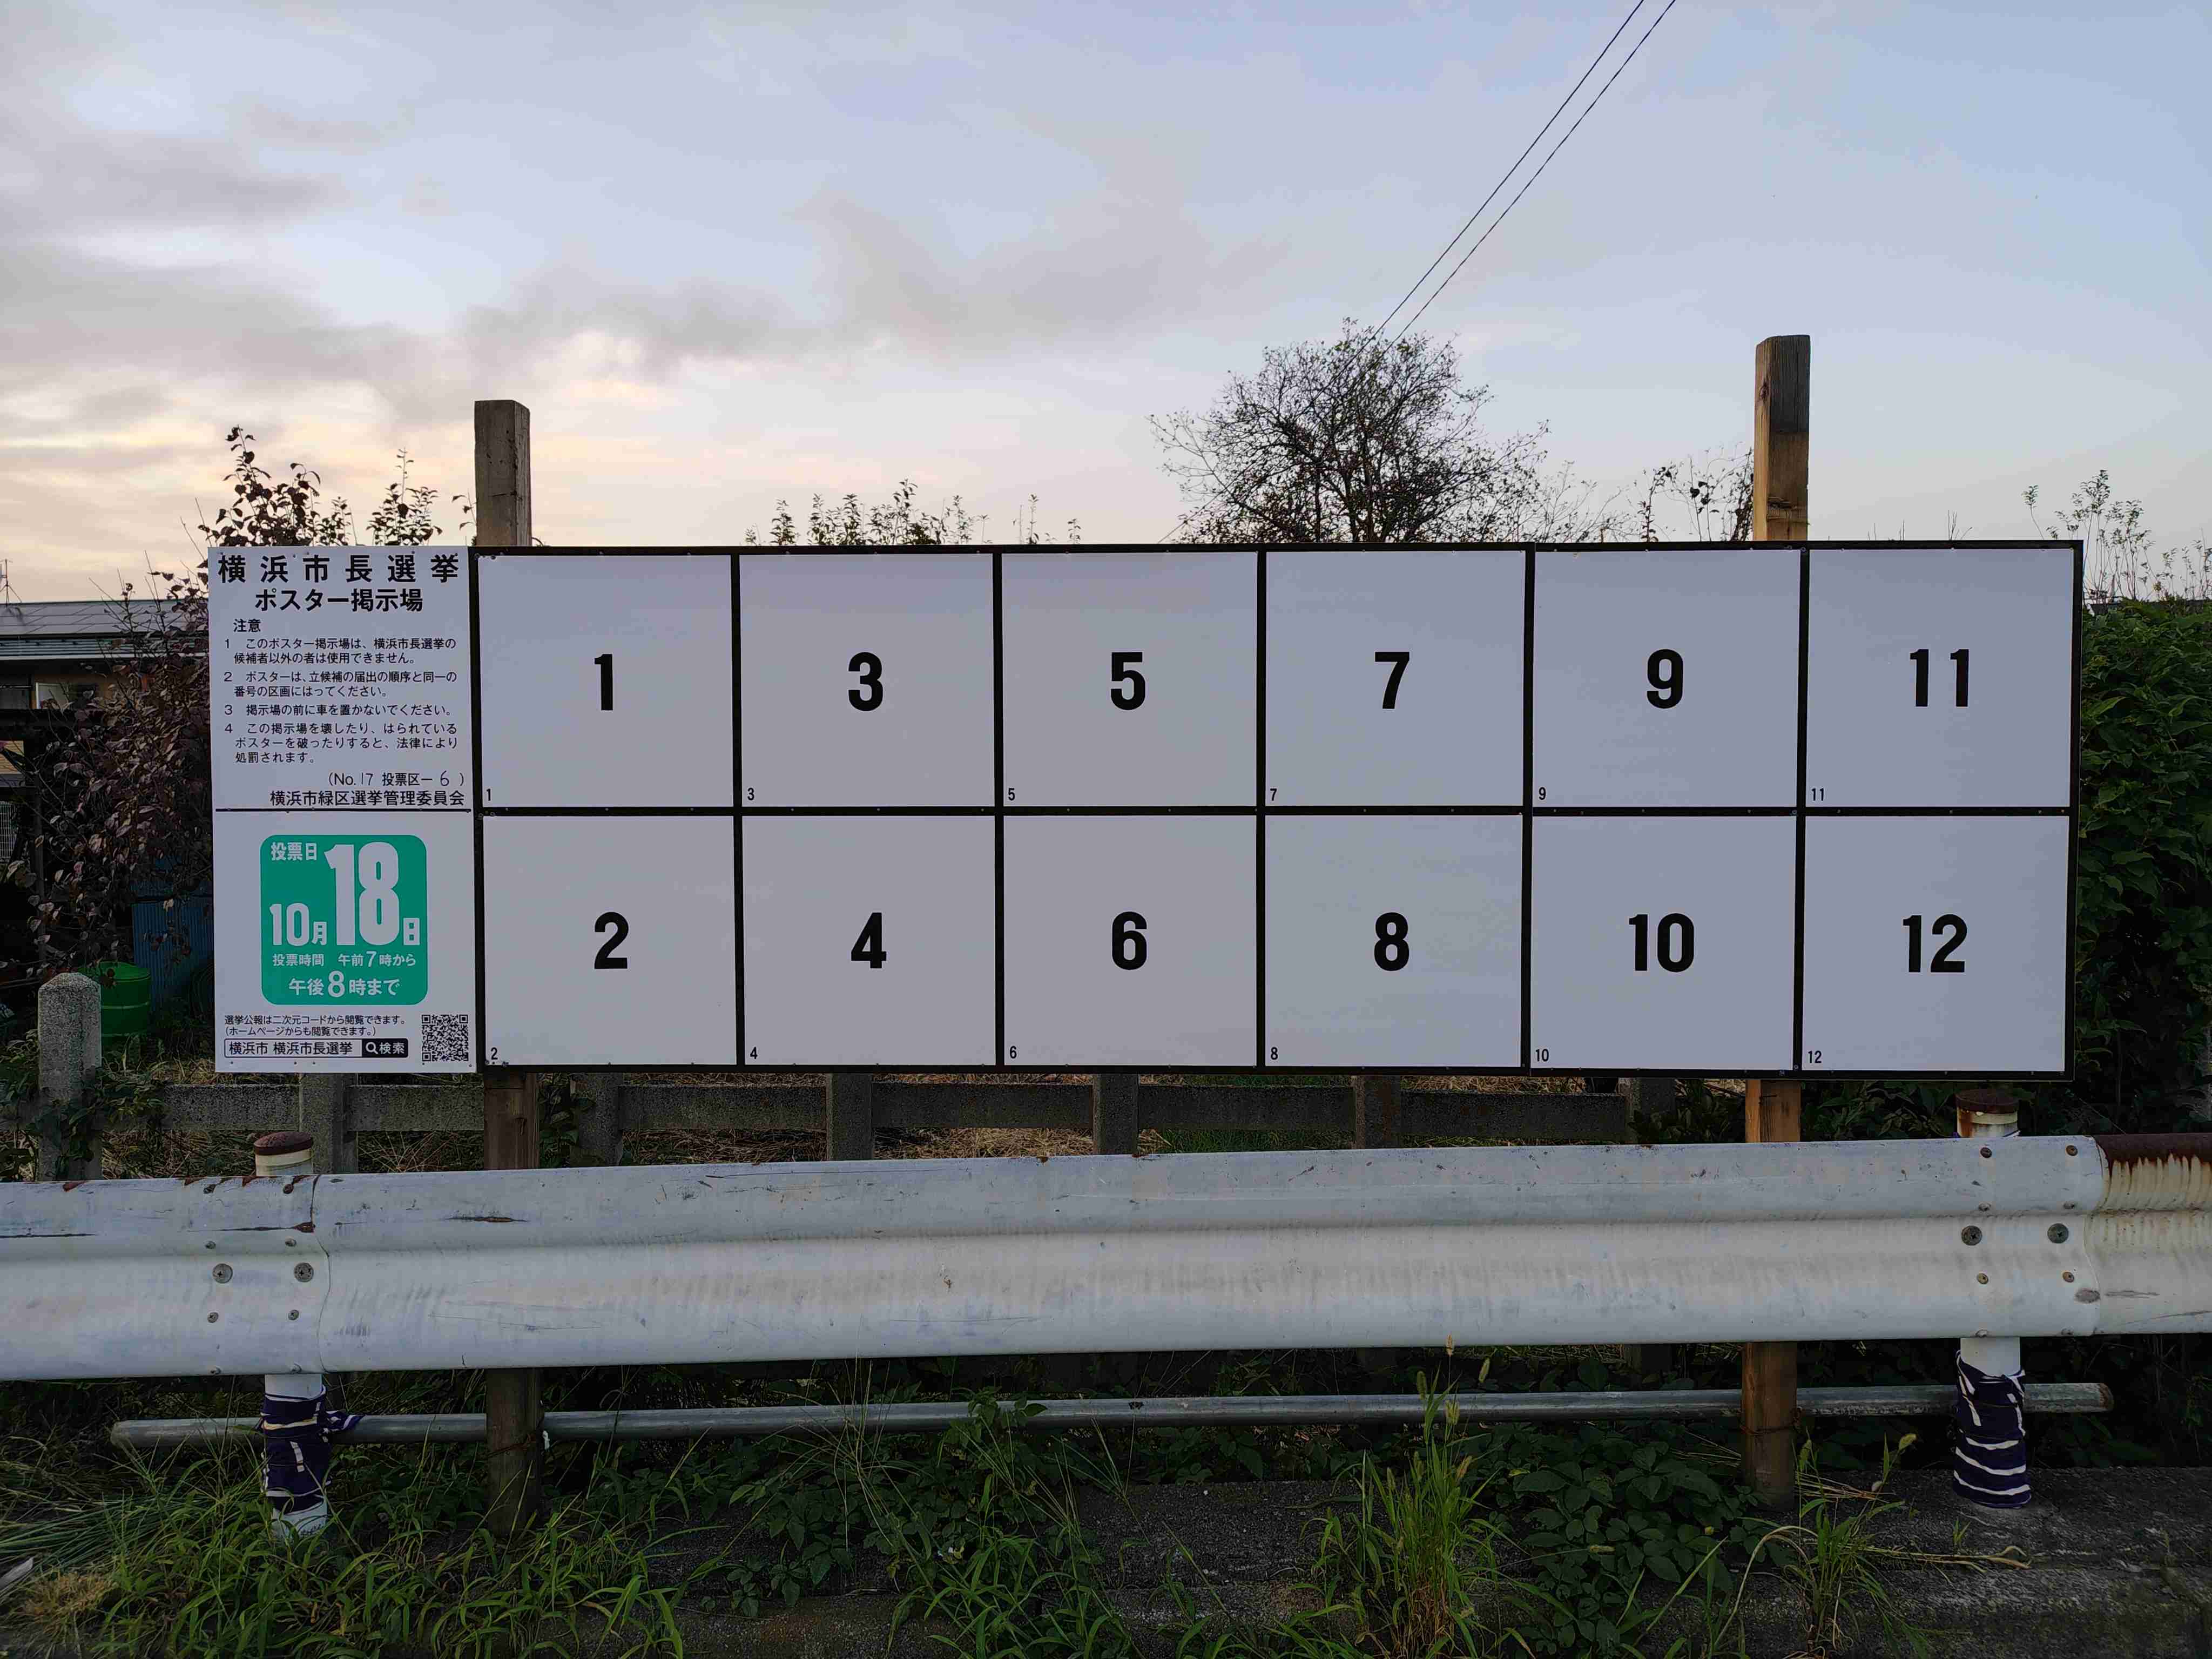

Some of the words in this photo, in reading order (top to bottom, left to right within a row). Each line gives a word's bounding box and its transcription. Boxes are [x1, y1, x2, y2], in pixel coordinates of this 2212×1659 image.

[218, 554, 459, 584] 横浜市長選挙
[254, 588, 423, 612] ポスター掲示場
[233, 618, 261, 633] 注意
[225, 638, 230, 649] 1
[233, 652, 414, 664] 候補者以外の者は使用できません。
[224, 671, 233, 682] 2
[594, 653, 613, 711] 1
[848, 651, 884, 712] 3
[1110, 651, 1146, 711] 5
[1374, 651, 1410, 710] 7
[1647, 649, 1684, 709] 9
[1910, 649, 1970, 707] 11
[234, 685, 386, 698] 番号の区画にはってください。
[224, 704, 233, 716] 3
[246, 704, 450, 716] 掲示場の前に車を置かないでください。
[224, 723, 233, 733] 4
[235, 751, 314, 764] 処罰されます。
[269, 790, 464, 806] 横浜市緑区選挙管理委員会
[486, 788, 491, 801] 1
[747, 787, 754, 801] 3
[1008, 787, 1015, 801] 5
[1270, 788, 1277, 801] 7
[1539, 786, 1546, 800] 9
[1811, 787, 1824, 801] 11
[271, 842, 317, 861] 投票日
[594, 912, 629, 969] 2
[851, 912, 887, 969] 4
[1111, 911, 1147, 970] 6
[1374, 912, 1410, 972] 8
[1628, 913, 1695, 973] 10
[1903, 914, 1968, 973] 12
[273, 954, 324, 966] 投票時間
[338, 950, 416, 967] 午前7時から
[289, 970, 399, 997] 午後8時まで
[224, 1015, 405, 1025] 選挙公報は二次元コードから閲覧できます。
[228, 1041, 268, 1055] 横浜市
[273, 1041, 353, 1055] 横浜市長選挙
[379, 1042, 404, 1054] 検索
[490, 1047, 498, 1060] 2
[750, 1047, 758, 1060] 4
[1009, 1045, 1017, 1059] 6
[1270, 1047, 1278, 1060] 8
[1535, 1048, 1549, 1062] 10
[1808, 1050, 1822, 1064] 12
